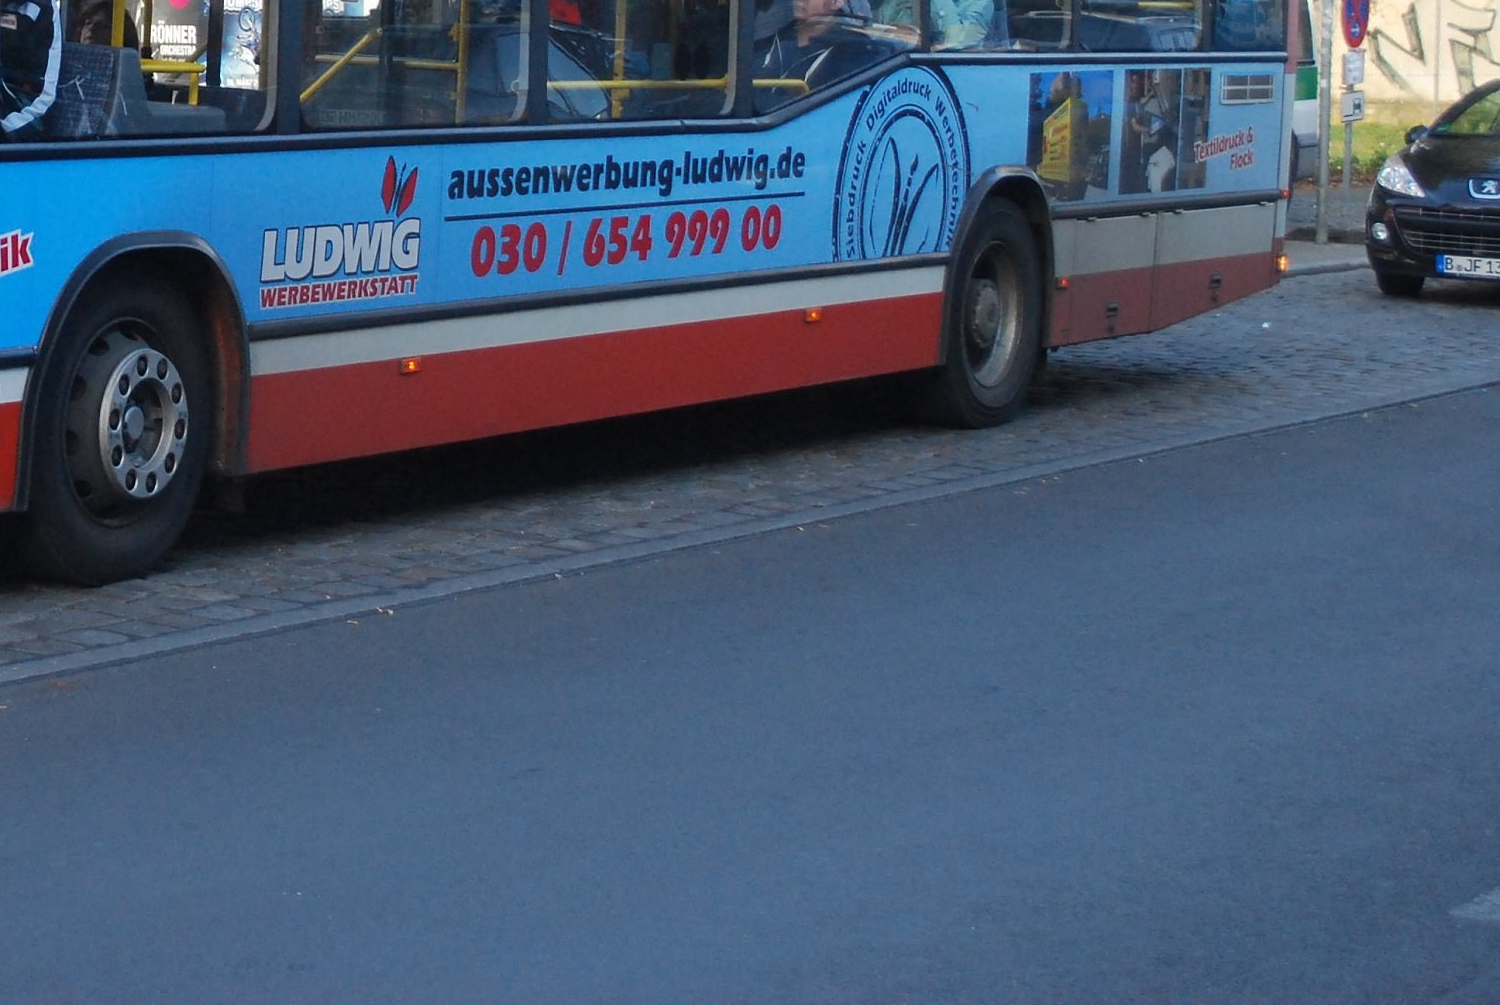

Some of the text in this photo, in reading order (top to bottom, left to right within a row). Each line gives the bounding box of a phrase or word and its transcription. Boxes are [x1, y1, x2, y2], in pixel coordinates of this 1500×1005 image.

[141, 20, 197, 44] RÖNNER
[866, 78, 932, 132] Digitaldruck
[1194, 128, 1245, 163] Textildruck
[1230, 150, 1254, 170] Flock
[447, 146, 805, 198] aussenwerbung-ludwig.de
[846, 140, 867, 258] Siebdruck
[260, 217, 421, 283] LUDWIG
[471, 222, 547, 277] 030
[582, 214, 653, 267] 654
[665, 208, 730, 259] 999
[741, 204, 782, 252] 00
[1445, 257, 1453, 271] B
[1464, 259, 1482, 272] JF
[260, 274, 420, 310] WERBEWERKSTATT
